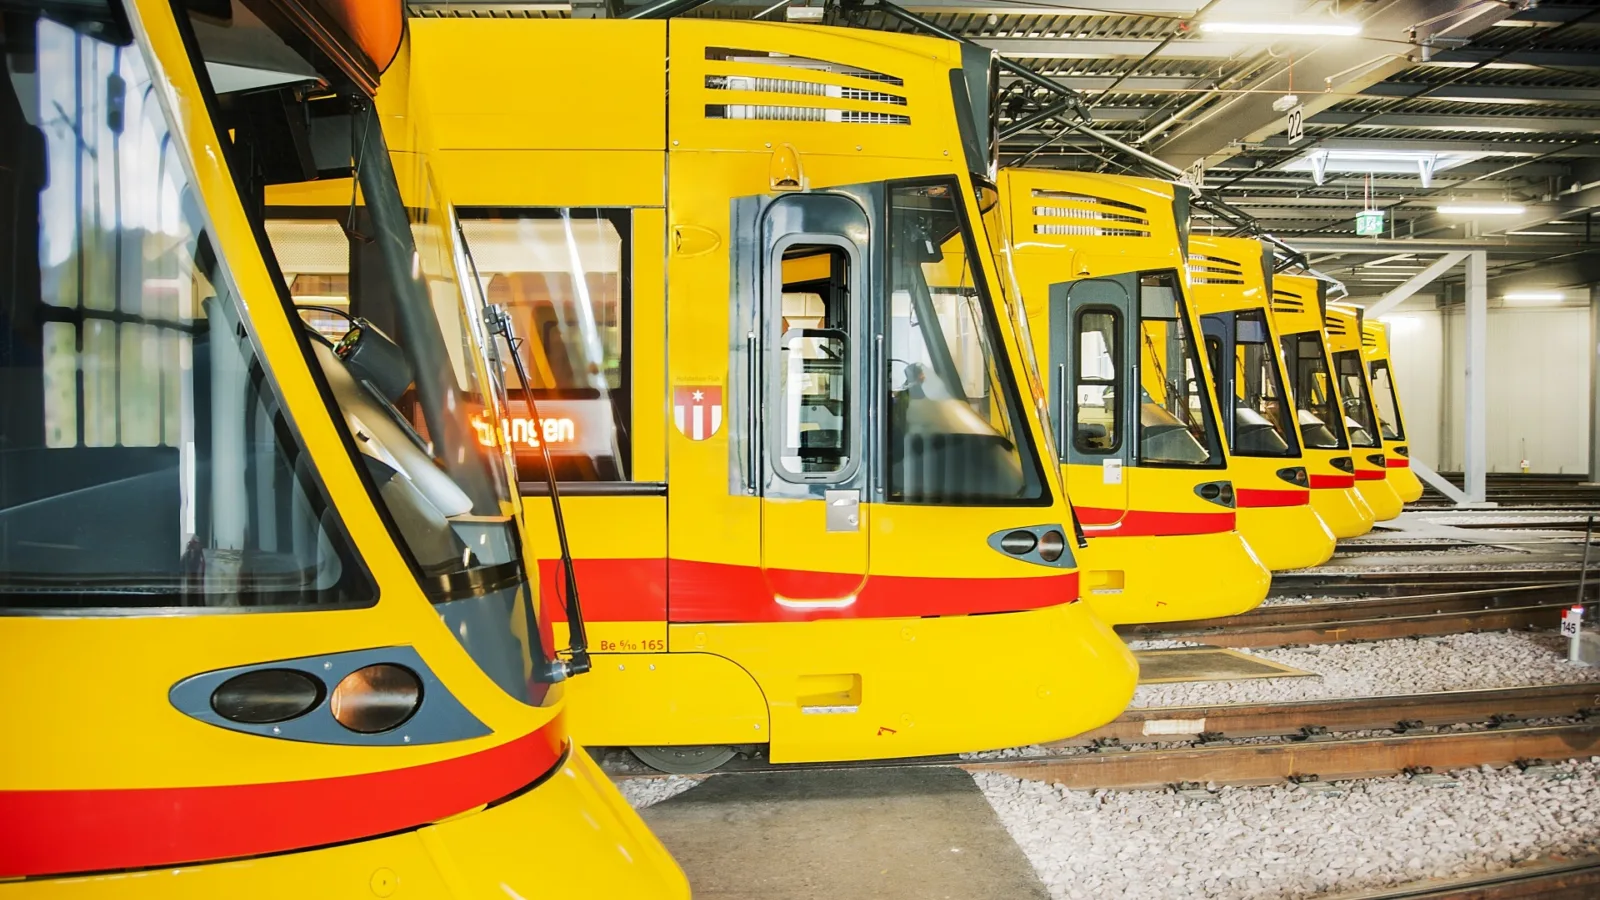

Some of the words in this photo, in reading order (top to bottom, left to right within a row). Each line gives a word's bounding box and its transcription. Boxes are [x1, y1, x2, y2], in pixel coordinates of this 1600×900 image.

[1289, 110, 1302, 140] 22
[1562, 621, 1577, 635] 145
[600, 640, 616, 651] Be
[641, 639, 664, 650] 165
